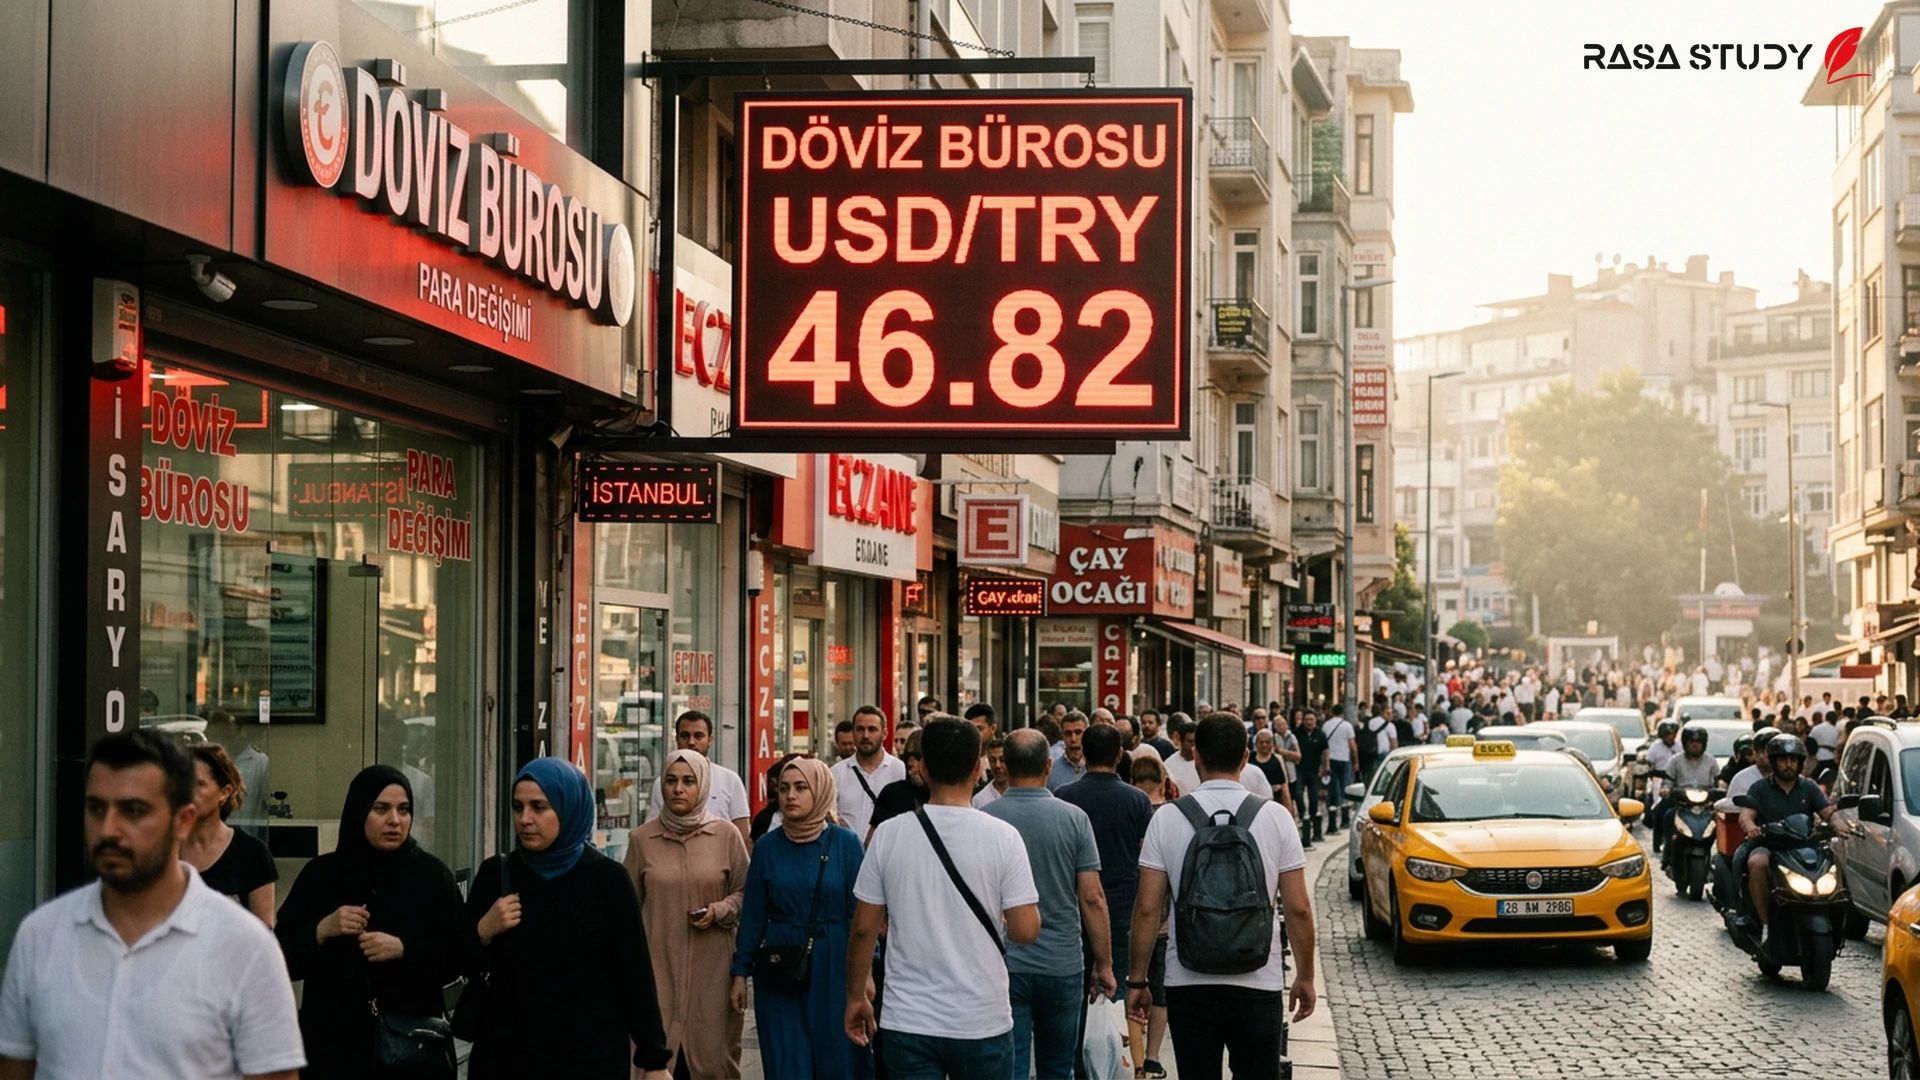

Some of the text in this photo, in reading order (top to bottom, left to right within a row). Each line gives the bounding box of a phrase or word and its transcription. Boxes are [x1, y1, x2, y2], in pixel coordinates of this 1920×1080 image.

[762, 114, 1167, 170] DÖVİZ BÜROSU
[354, 59, 470, 247] DÖVİZ
[480, 132, 603, 310] BÜROSU
[773, 195, 1159, 264] USD/TRY
[419, 262, 463, 315] PARA
[767, 289, 1154, 408] 46.82
[406, 448, 457, 500] PARA
[593, 476, 705, 505] İSTANBUL
[1069, 547, 1128, 576] ÇAY
[1051, 575, 1146, 604] OCAĞI
